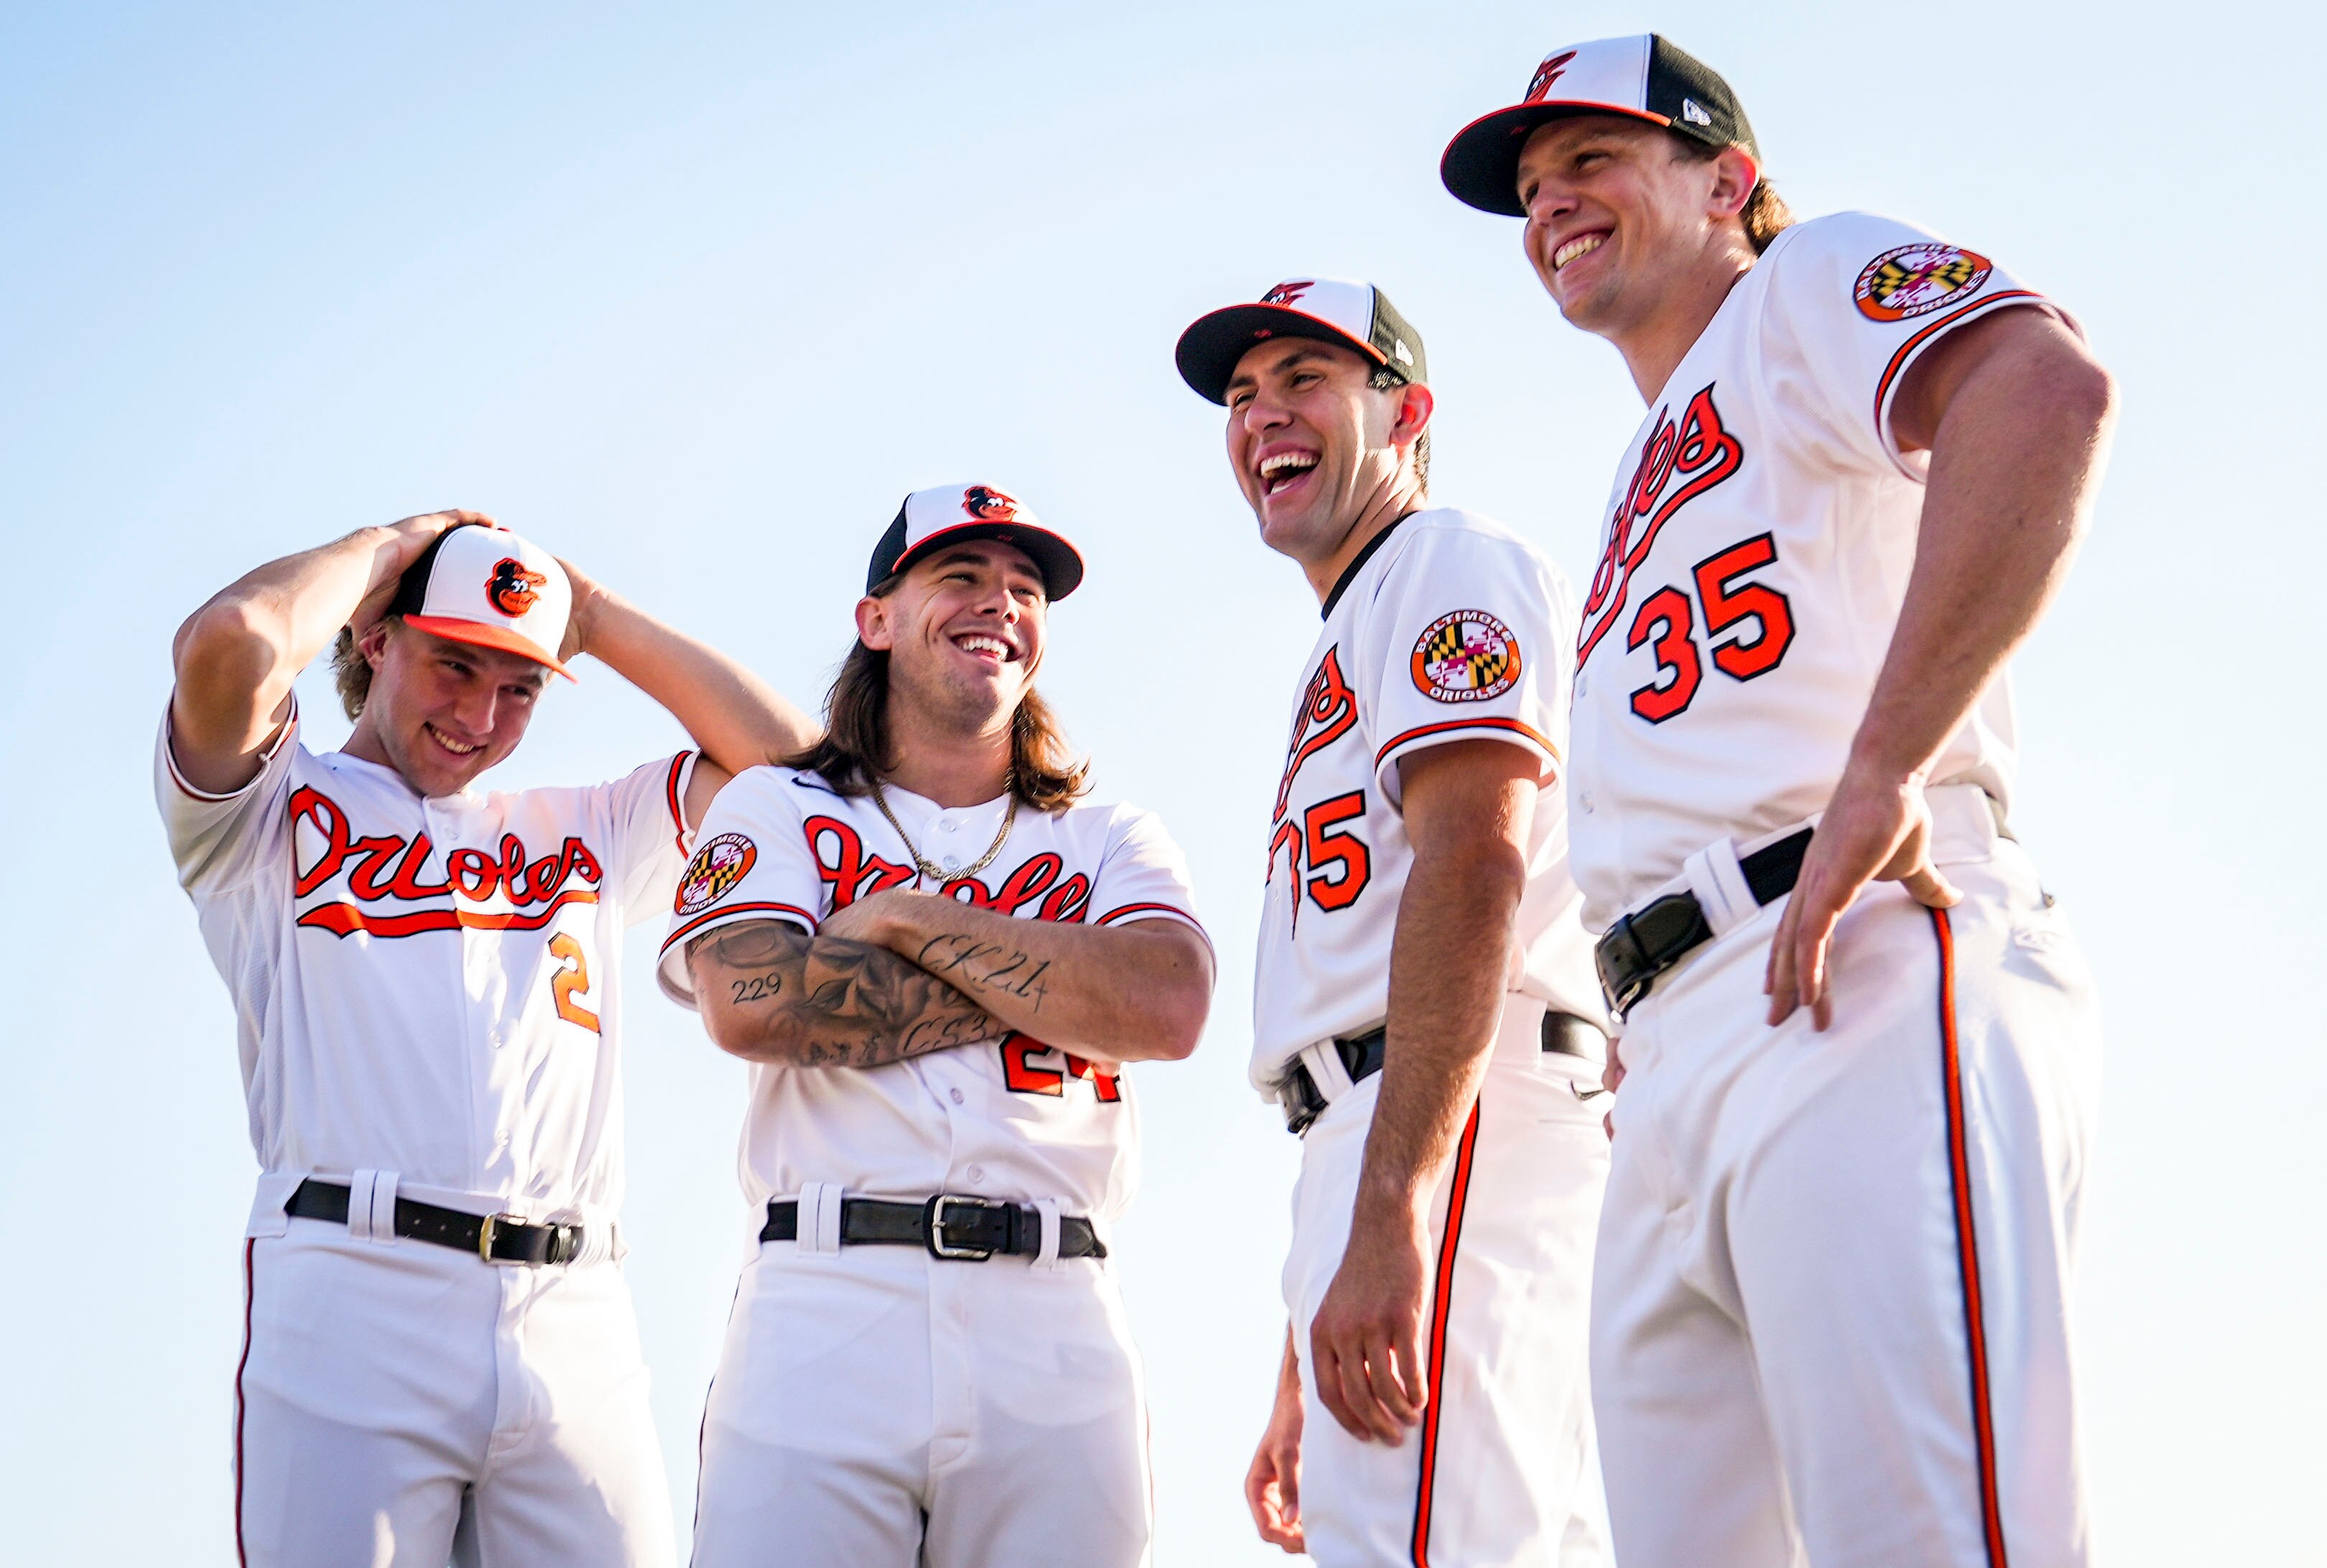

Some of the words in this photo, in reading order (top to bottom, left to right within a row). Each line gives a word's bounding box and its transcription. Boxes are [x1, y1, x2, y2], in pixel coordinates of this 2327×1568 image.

[1578, 381, 1744, 677] oles
[1415, 610, 1514, 654] BALTIMORE
[1627, 530, 1796, 725] 35
[1429, 677, 1509, 702] ORIOLES
[288, 784, 603, 908] Orioles
[802, 815, 1090, 924] Orole
[547, 931, 602, 1036] 2
[731, 972, 782, 1005] 229
